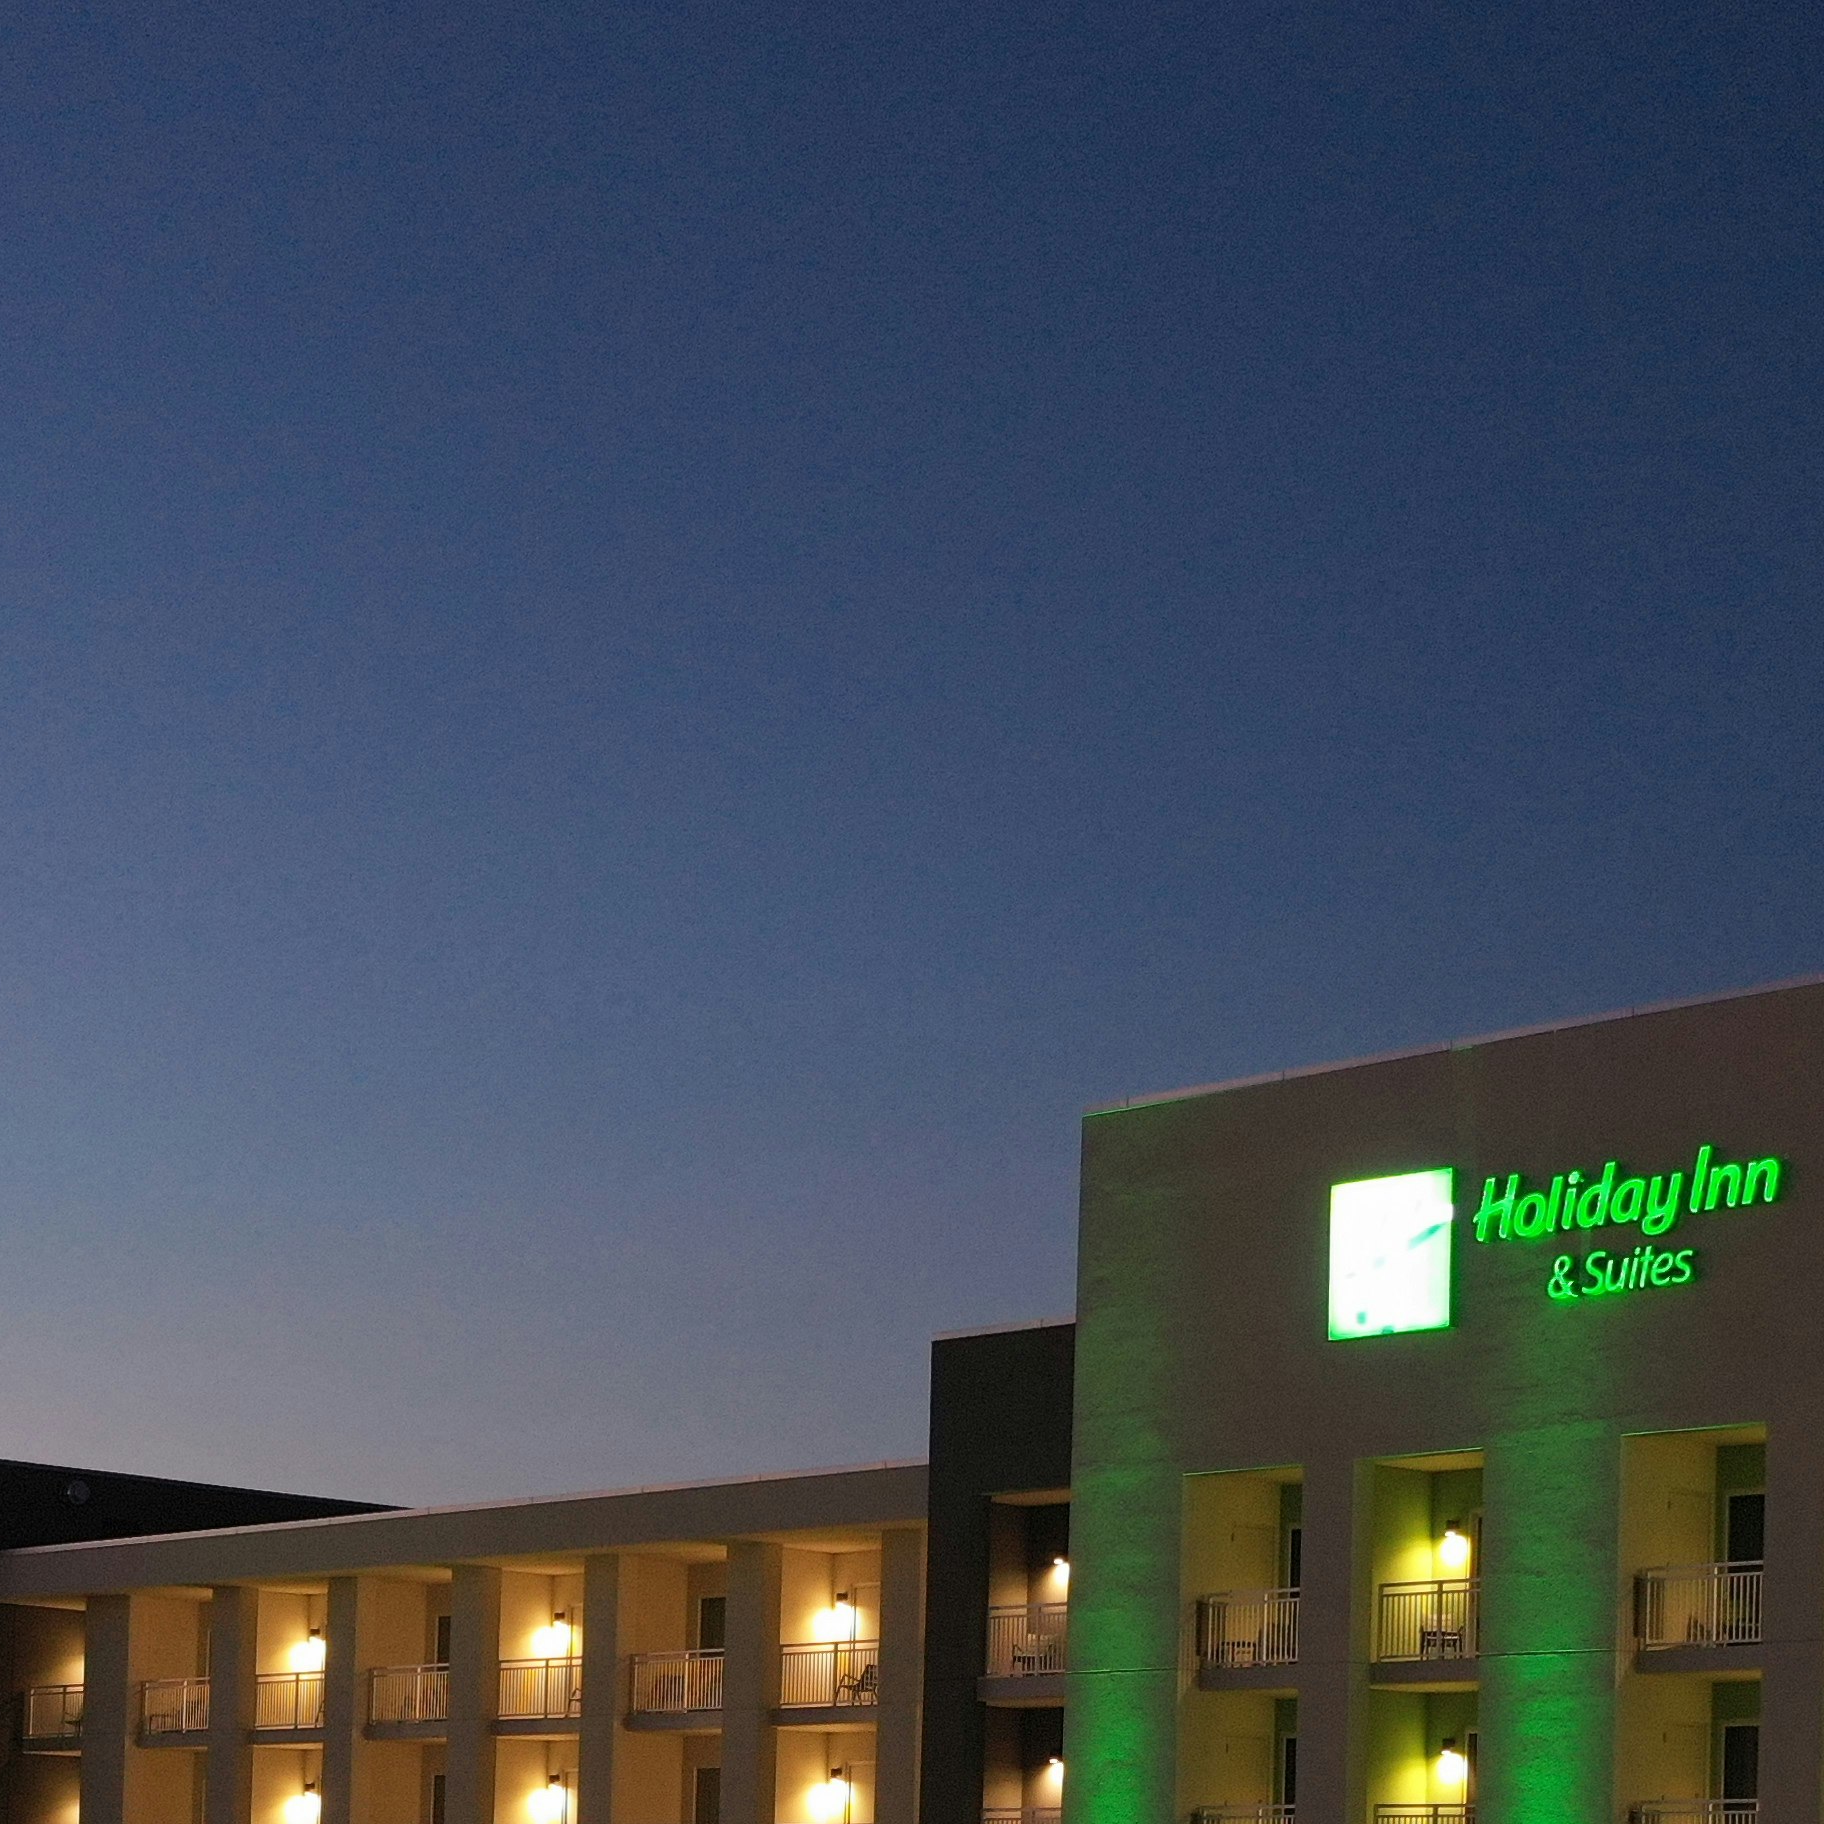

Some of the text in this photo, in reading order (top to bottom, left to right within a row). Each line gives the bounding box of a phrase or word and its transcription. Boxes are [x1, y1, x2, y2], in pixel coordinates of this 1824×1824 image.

[1473, 1145, 1780, 1243] Holiday Inn
[1547, 1247, 1694, 1298] & Suites
